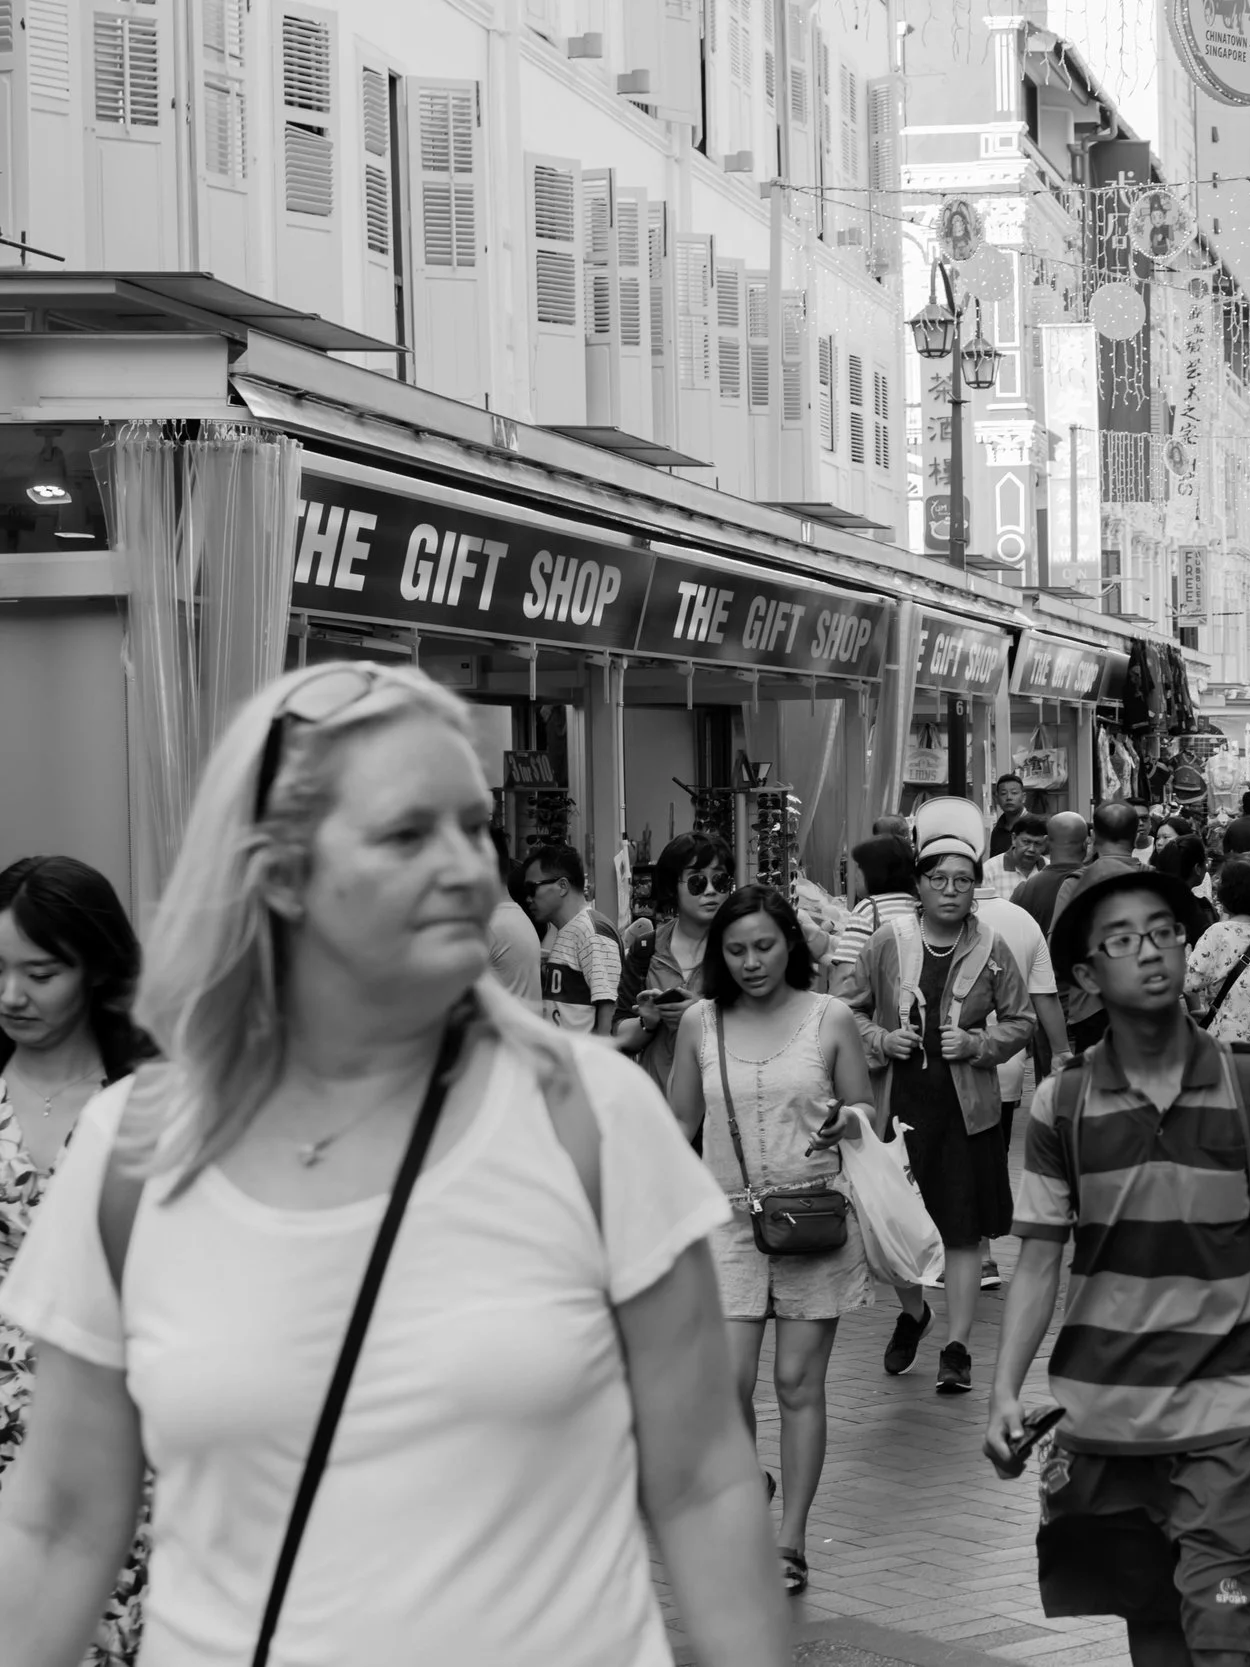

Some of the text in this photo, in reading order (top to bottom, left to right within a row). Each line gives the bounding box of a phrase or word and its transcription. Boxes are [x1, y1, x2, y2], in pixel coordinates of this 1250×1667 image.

[1205, 30, 1248, 48] CHINATOWN
[1205, 44, 1247, 63] SINGAPORE
[399, 522, 509, 611] GIFT
[521, 549, 622, 627] SHOP
[672, 580, 872, 664] THE GIFT SHOP
[930, 633, 964, 678] GIFT
[964, 642, 999, 684] SHOP
[1029, 651, 1099, 693] THE GIFT SHOP
[955, 700, 964, 716] 6
[508, 754, 521, 782] 3
